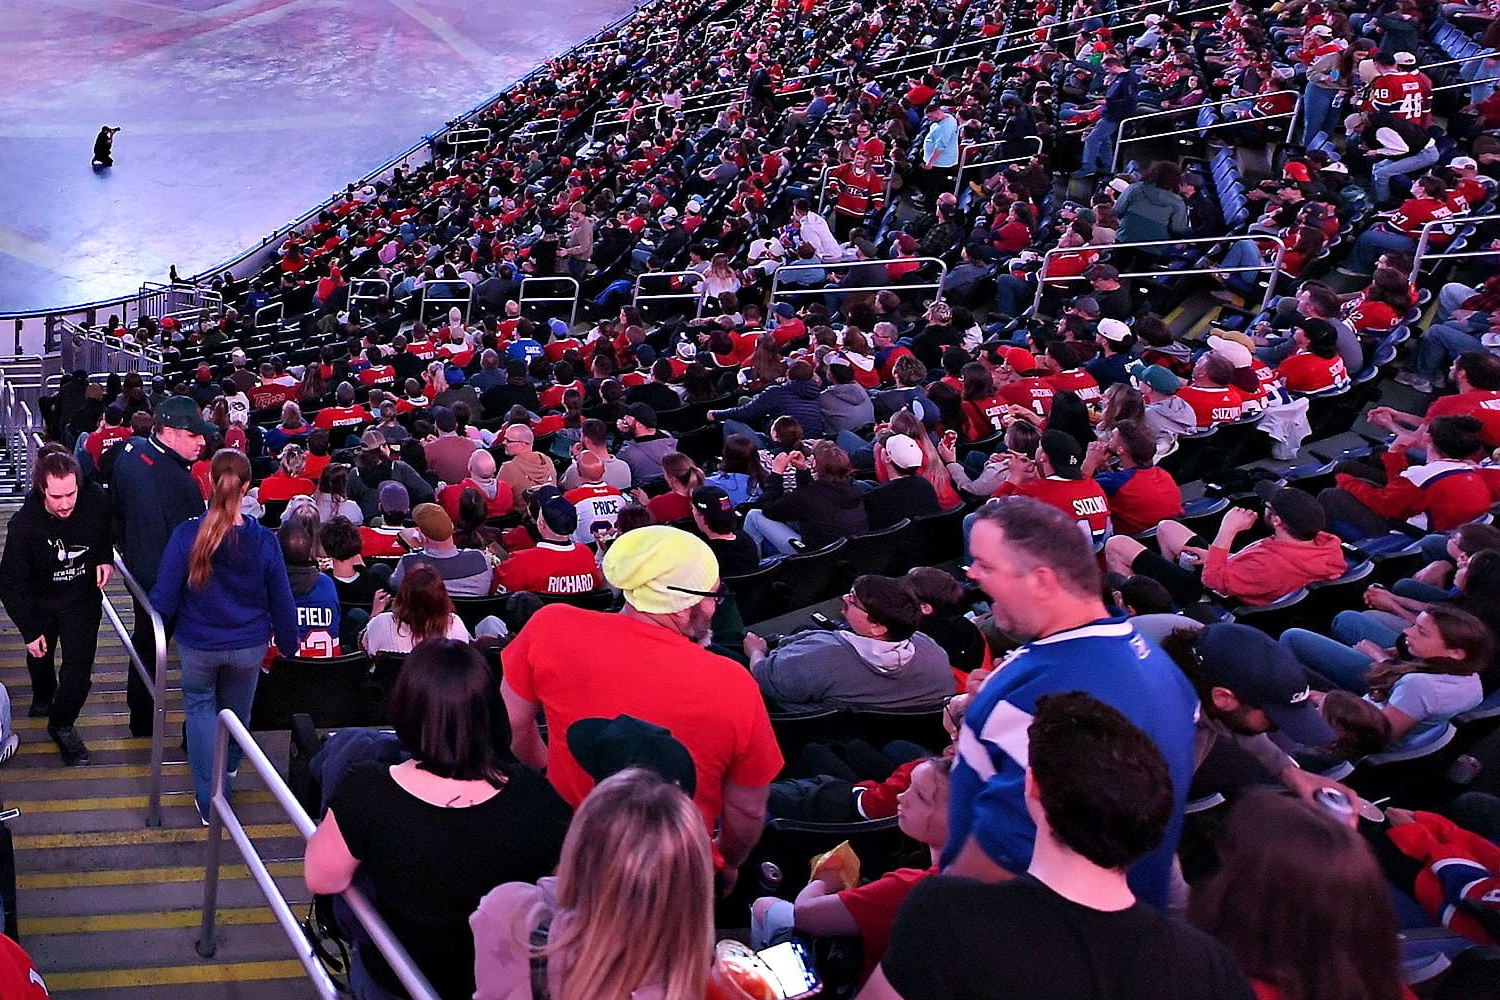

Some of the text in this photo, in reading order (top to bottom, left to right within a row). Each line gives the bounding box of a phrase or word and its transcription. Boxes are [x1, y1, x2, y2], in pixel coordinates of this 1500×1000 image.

[593, 500, 618, 516] PRICE
[548, 574, 593, 593] RICHARD
[297, 607, 332, 626] FIELD
